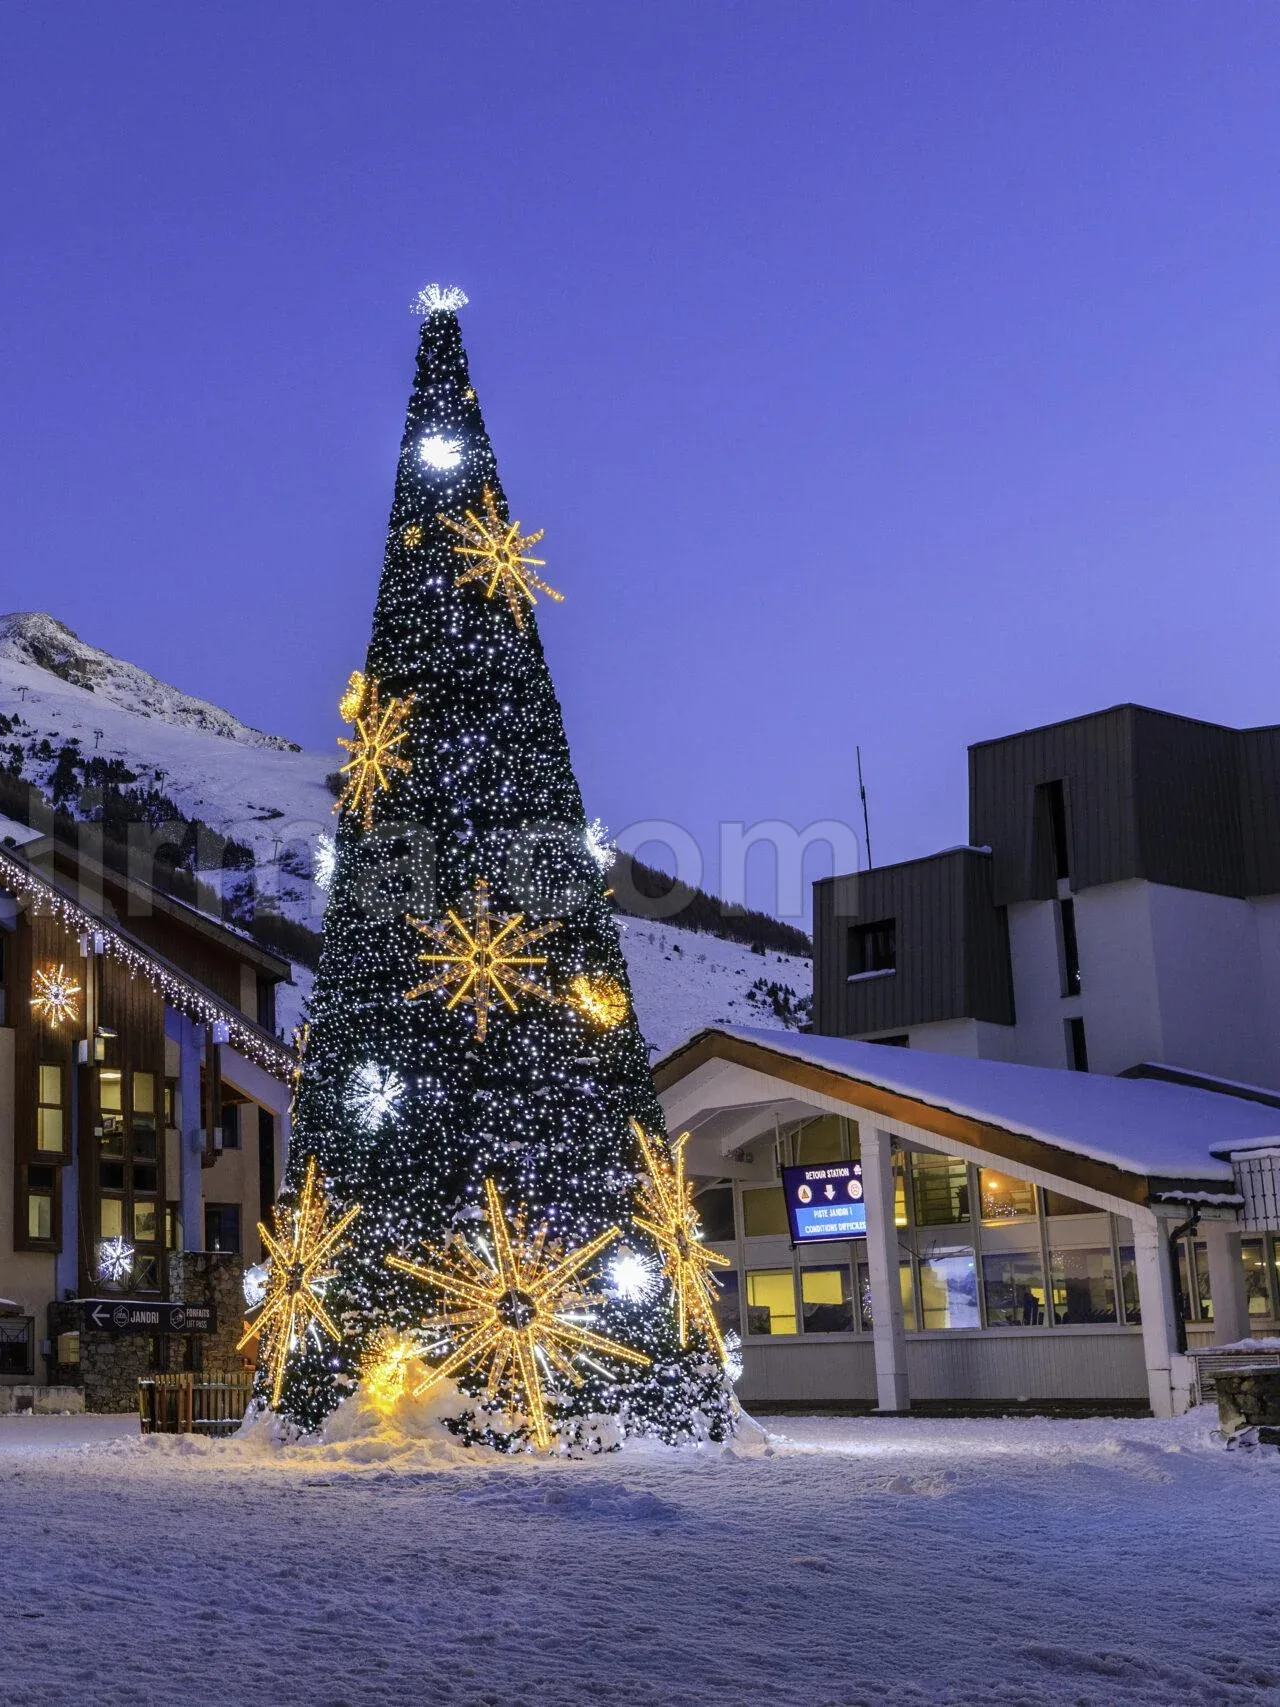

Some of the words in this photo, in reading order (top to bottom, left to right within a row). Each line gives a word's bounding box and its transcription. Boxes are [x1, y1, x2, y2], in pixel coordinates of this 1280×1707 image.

[805, 1170, 826, 1180] RETOUR
[827, 1168, 849, 1178] STATION
[804, 1223, 838, 1233] CONDITIONS
[130, 1311, 159, 1324] JANDRI
[186, 1309, 210, 1318] FORFAITS
